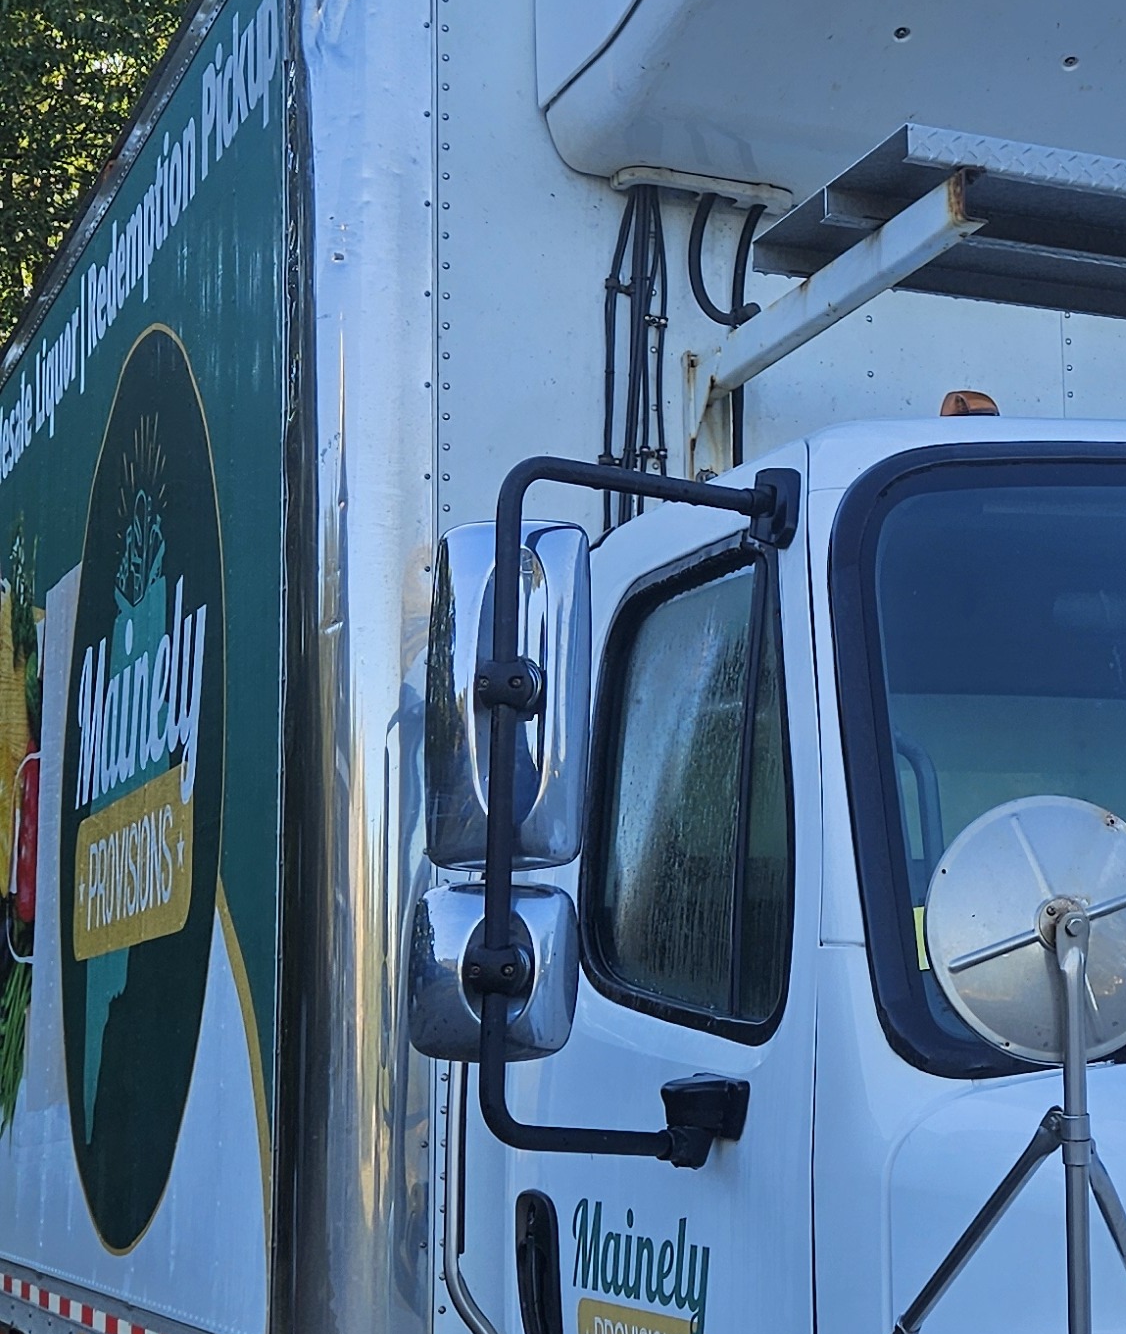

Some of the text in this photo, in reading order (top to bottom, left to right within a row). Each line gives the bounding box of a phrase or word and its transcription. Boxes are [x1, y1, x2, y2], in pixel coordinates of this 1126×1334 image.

[35, 306, 78, 438] Liquor
[87, 116, 196, 357] Redemption
[75, 574, 207, 810] Mainely
[87, 803, 173, 931] PROVISIONS
